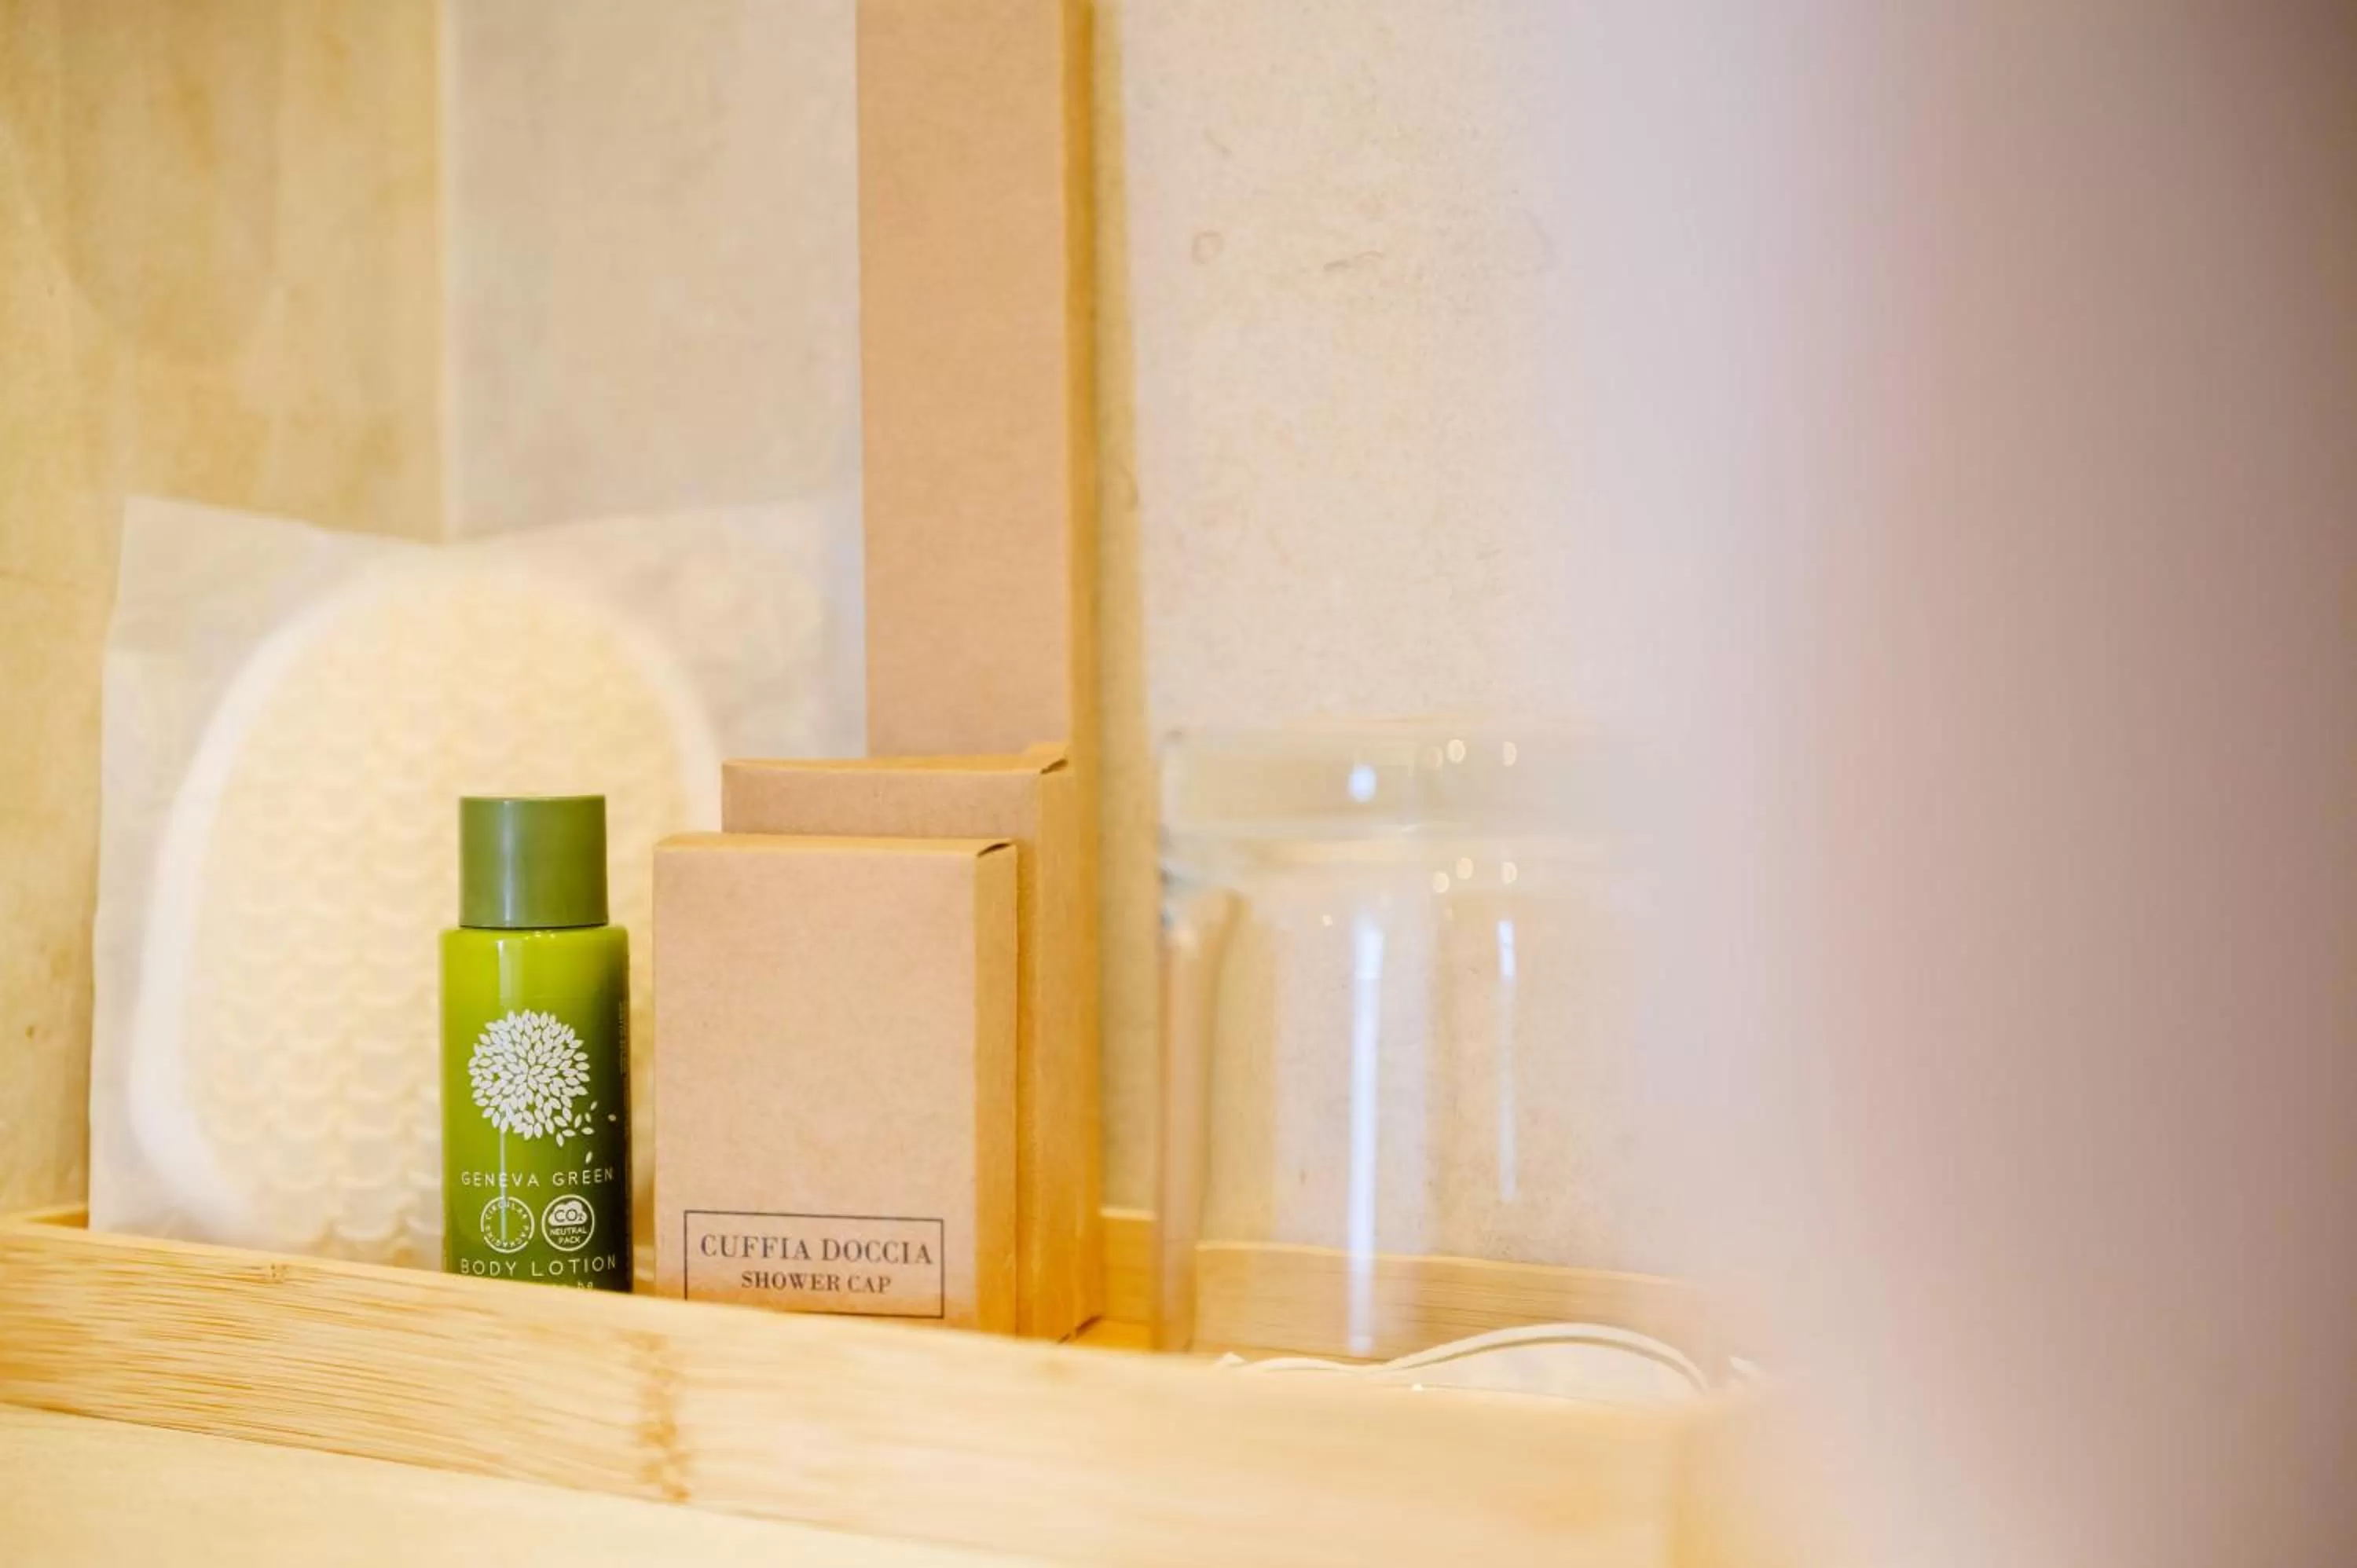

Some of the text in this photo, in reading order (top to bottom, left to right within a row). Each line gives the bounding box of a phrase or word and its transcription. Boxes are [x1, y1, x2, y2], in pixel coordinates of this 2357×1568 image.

[461, 1167, 615, 1188] GENEVA GREEN
[550, 1227, 587, 1236] NEUTRAL
[700, 1234, 933, 1265] CUFFIA DOCCIA
[460, 1255, 617, 1277] BODY LOTION
[741, 1270, 892, 1294] SHOWER CAP
